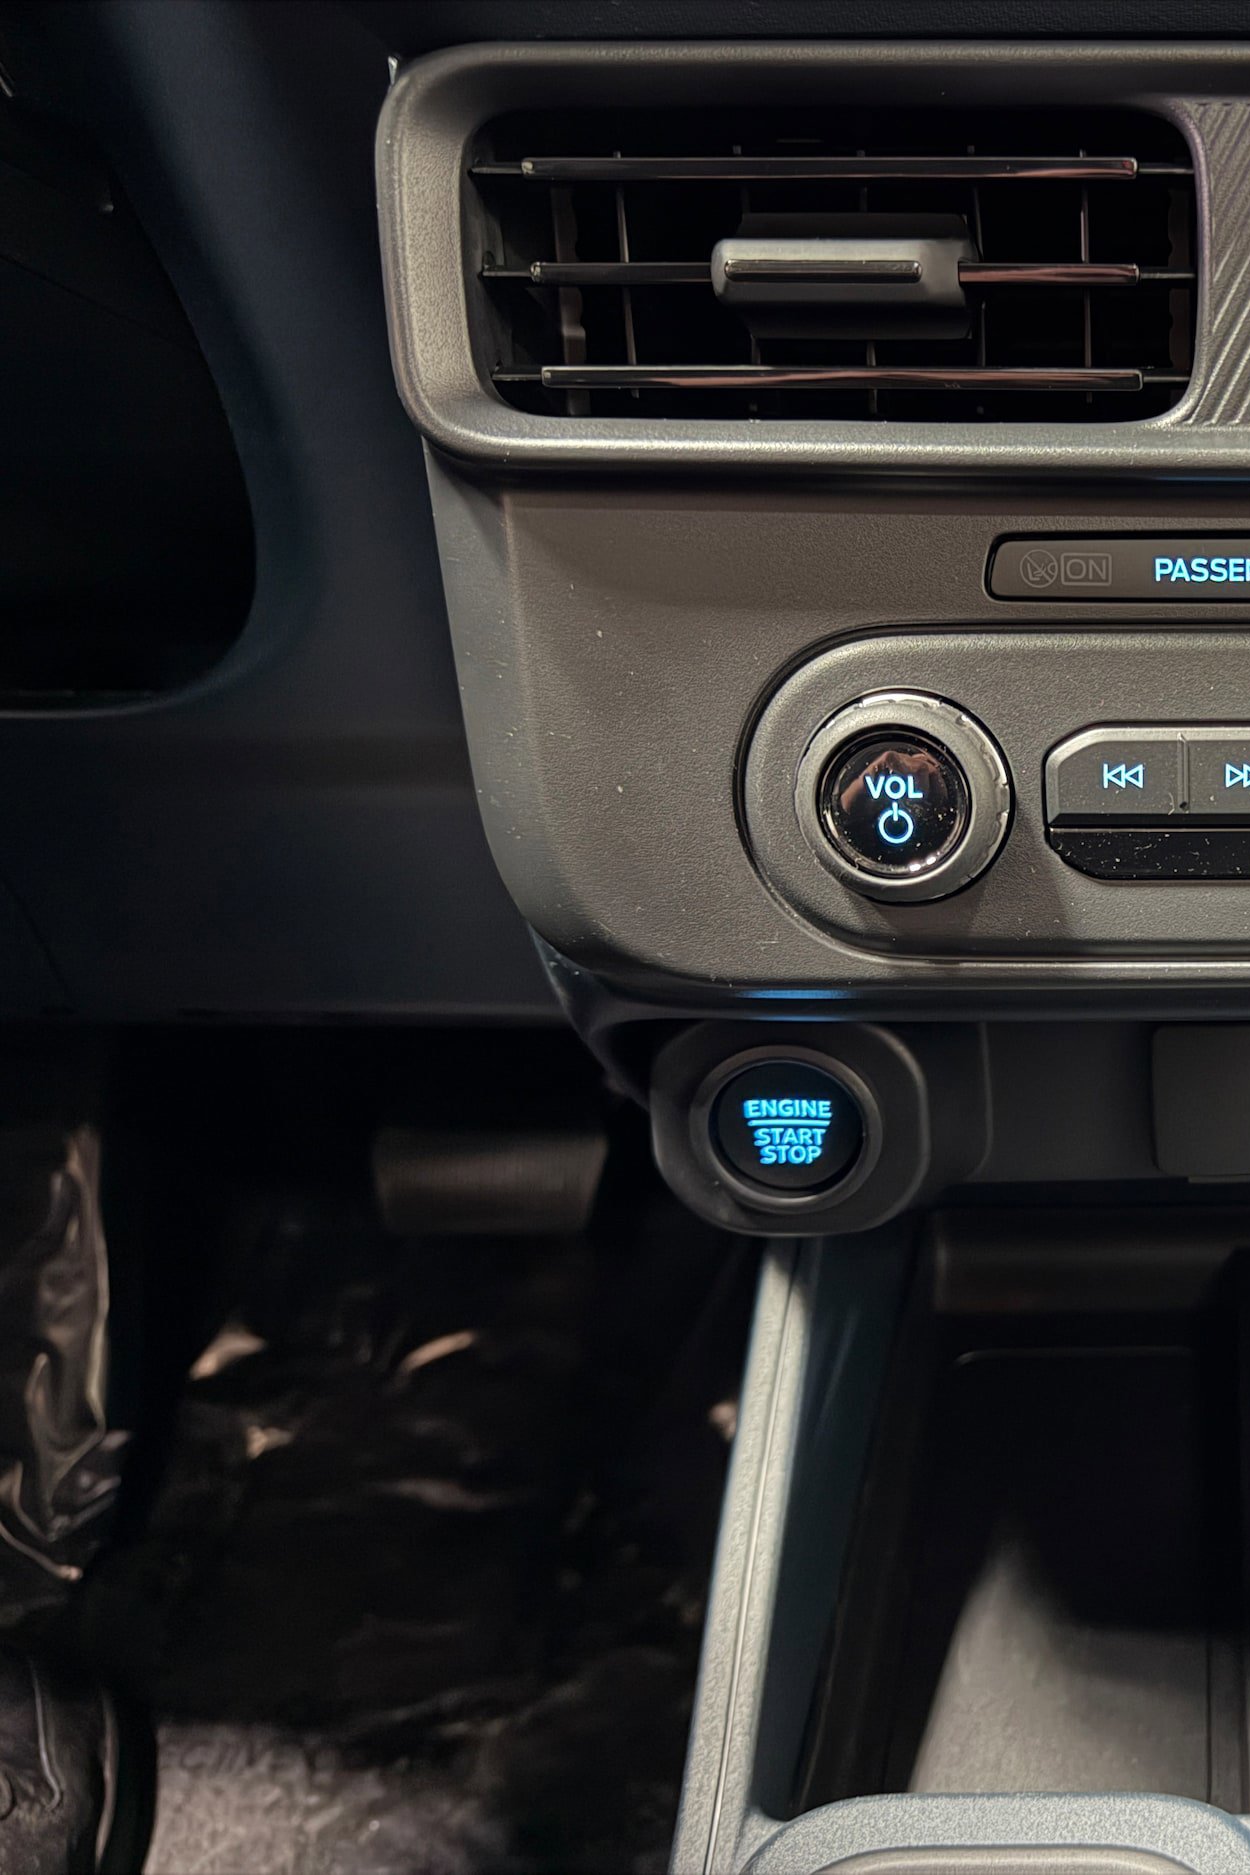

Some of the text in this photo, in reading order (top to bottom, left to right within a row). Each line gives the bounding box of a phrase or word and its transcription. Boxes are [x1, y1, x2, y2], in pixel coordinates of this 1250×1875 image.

[1065, 558, 1107, 581] ON
[864, 775, 924, 800] VOL
[744, 1099, 832, 1119] ENGINE
[754, 1128, 826, 1147] START
[759, 1145, 822, 1165] STOP
